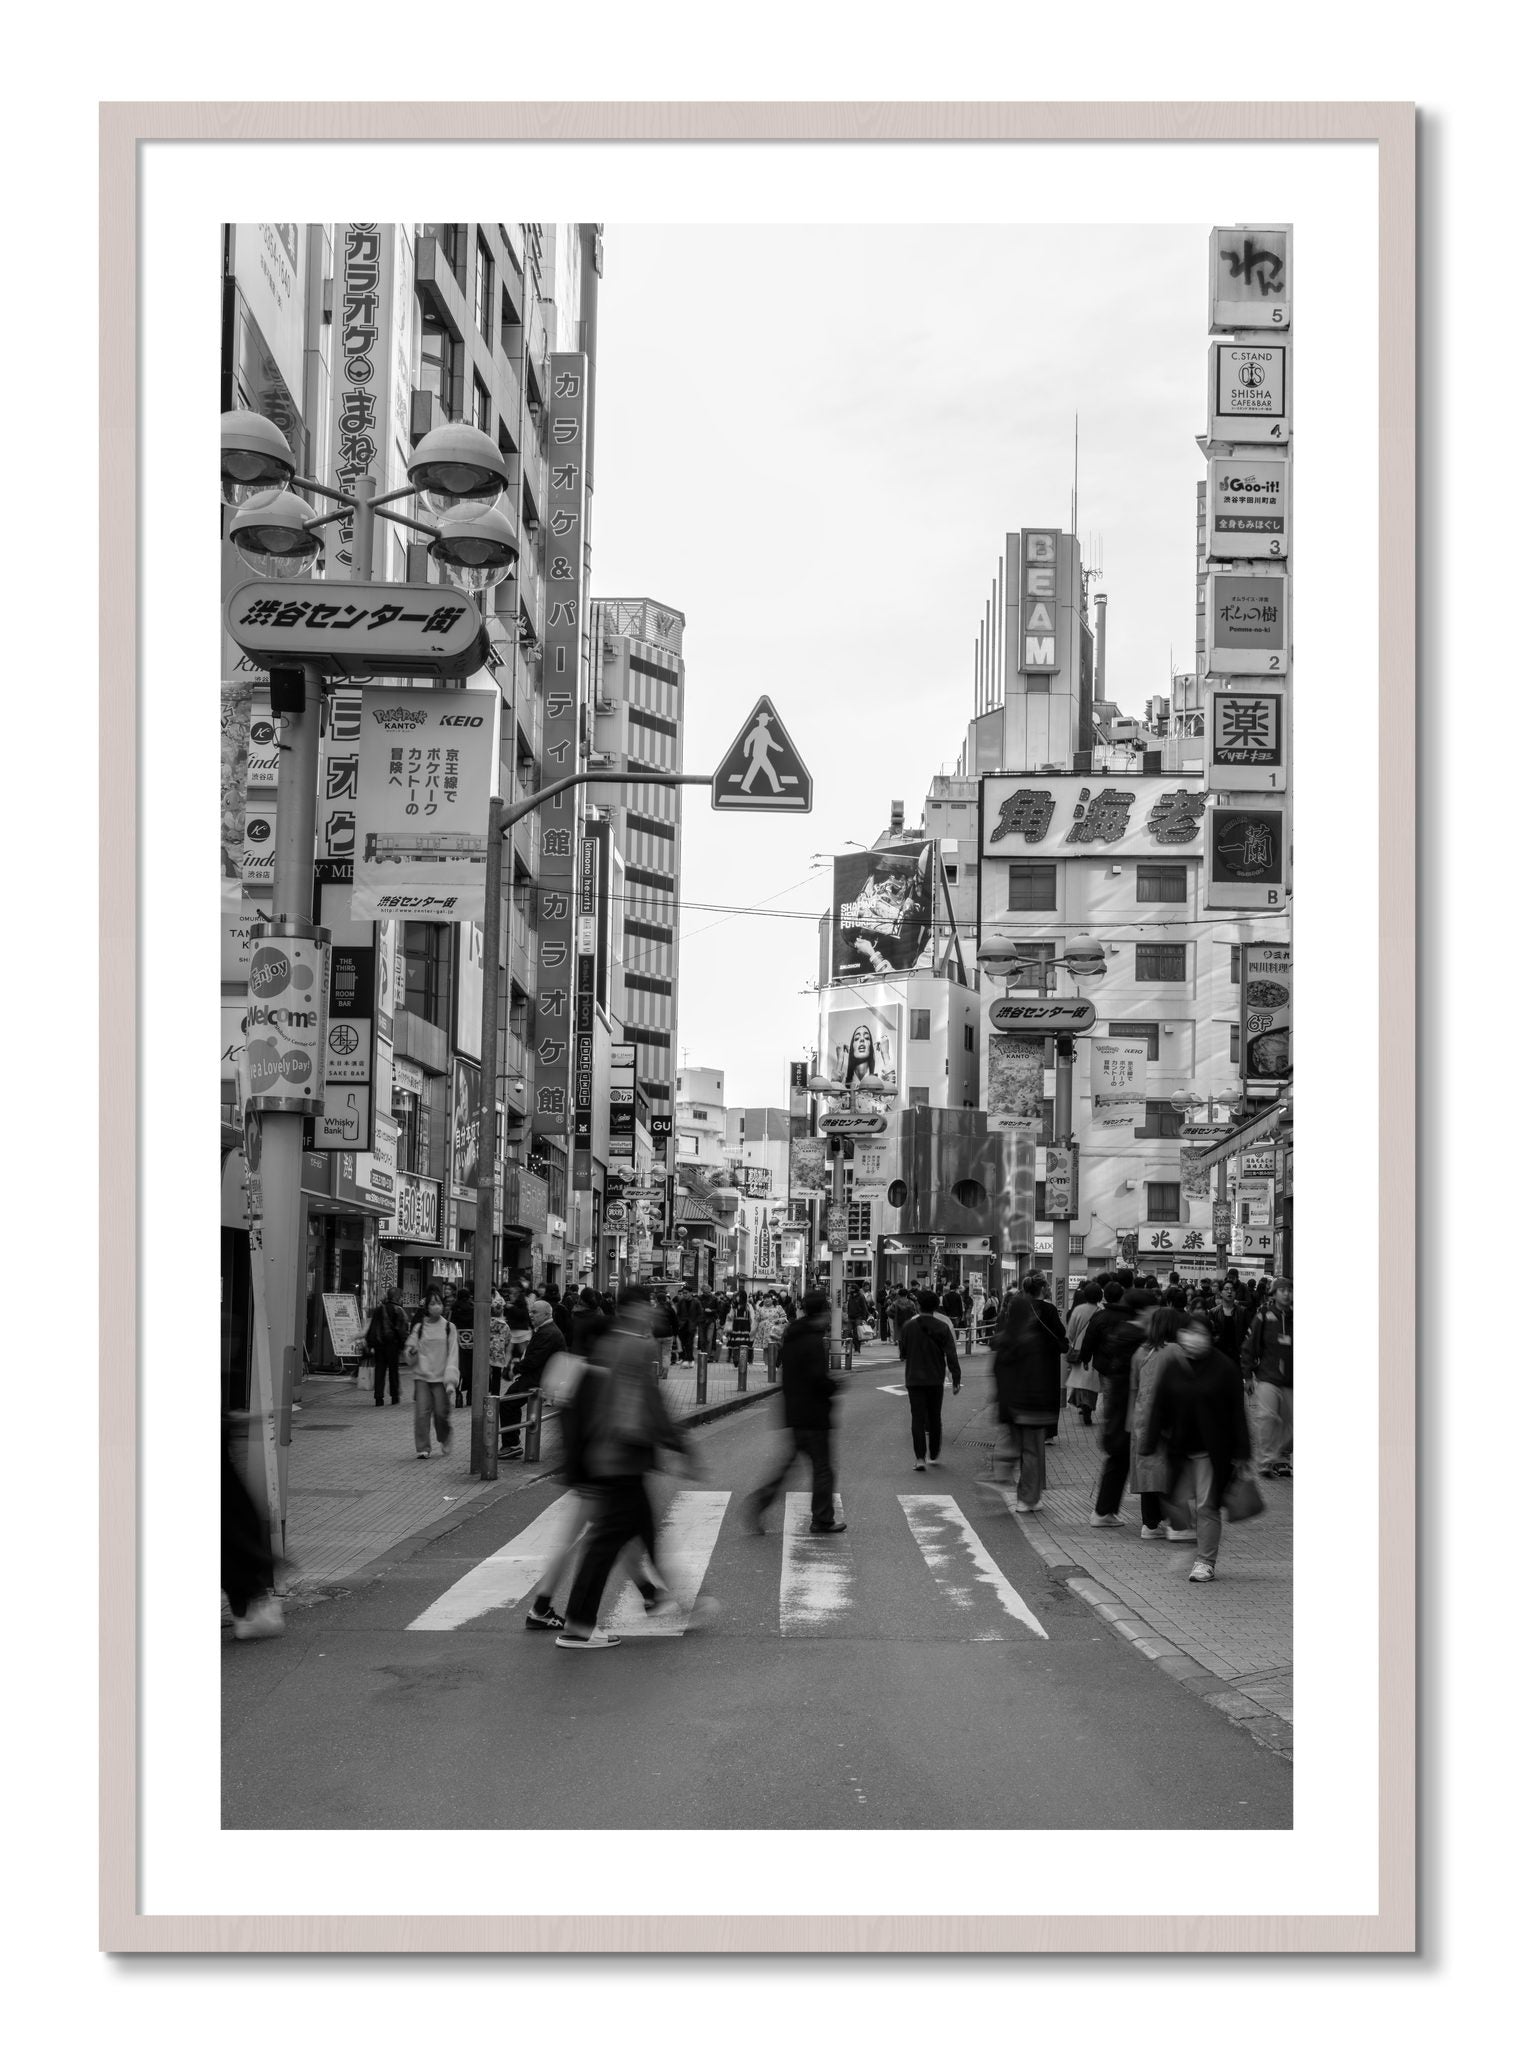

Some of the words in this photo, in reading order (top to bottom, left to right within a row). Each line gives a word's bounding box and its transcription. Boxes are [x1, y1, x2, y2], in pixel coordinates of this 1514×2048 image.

[344, 232, 380, 356] カラオケ
[1272, 309, 1283, 323] 5
[1231, 352, 1273, 361] C.STAND
[1231, 390, 1272, 399] SHISHA
[1230, 478, 1279, 493] Goo-it!
[1224, 496, 1276, 505] 渋谷宇田川町店
[1219, 519, 1281, 530] 全身もみほぐし
[1270, 540, 1280, 554] 3
[1026, 534, 1055, 665] BEAM
[240, 600, 466, 633] 渋谷センター街
[1220, 605, 1278, 622] ポムの樹
[1269, 656, 1280, 670] 2
[385, 722, 416, 730] KANTO
[440, 714, 484, 728] KEIO
[1222, 700, 1269, 747] 薬
[1217, 750, 1274, 763] マツモトキヨシ
[388, 747, 404, 787] 冒険へ
[405, 748, 422, 816] カントーの
[424, 748, 441, 816] ポケパーク
[443, 748, 459, 803] 京王線で
[1268, 773, 1277, 787] 1
[990, 787, 1208, 844] 角海老
[584, 842, 593, 875] kimono
[583, 879, 592, 910] hearts
[1267, 890, 1278, 904] B
[377, 896, 458, 908] 渋谷センター街
[339, 958, 353, 966] THE
[252, 959, 288, 990] Enjoy
[536, 893, 570, 1115] カラオケ館
[249, 1005, 318, 1028] Welcome
[996, 1006, 1090, 1019] 渋谷センター街
[1247, 1014, 1274, 1033] 6F
[263, 1058, 292, 1075] Lovely
[292, 1059, 311, 1072] Day!
[324, 1117, 355, 1128] Whisky
[653, 1121, 671, 1131] GU
[822, 1118, 878, 1127] 渋谷センター街
[324, 1126, 343, 1134] Bank
[760, 1228, 769, 1267] BEER
